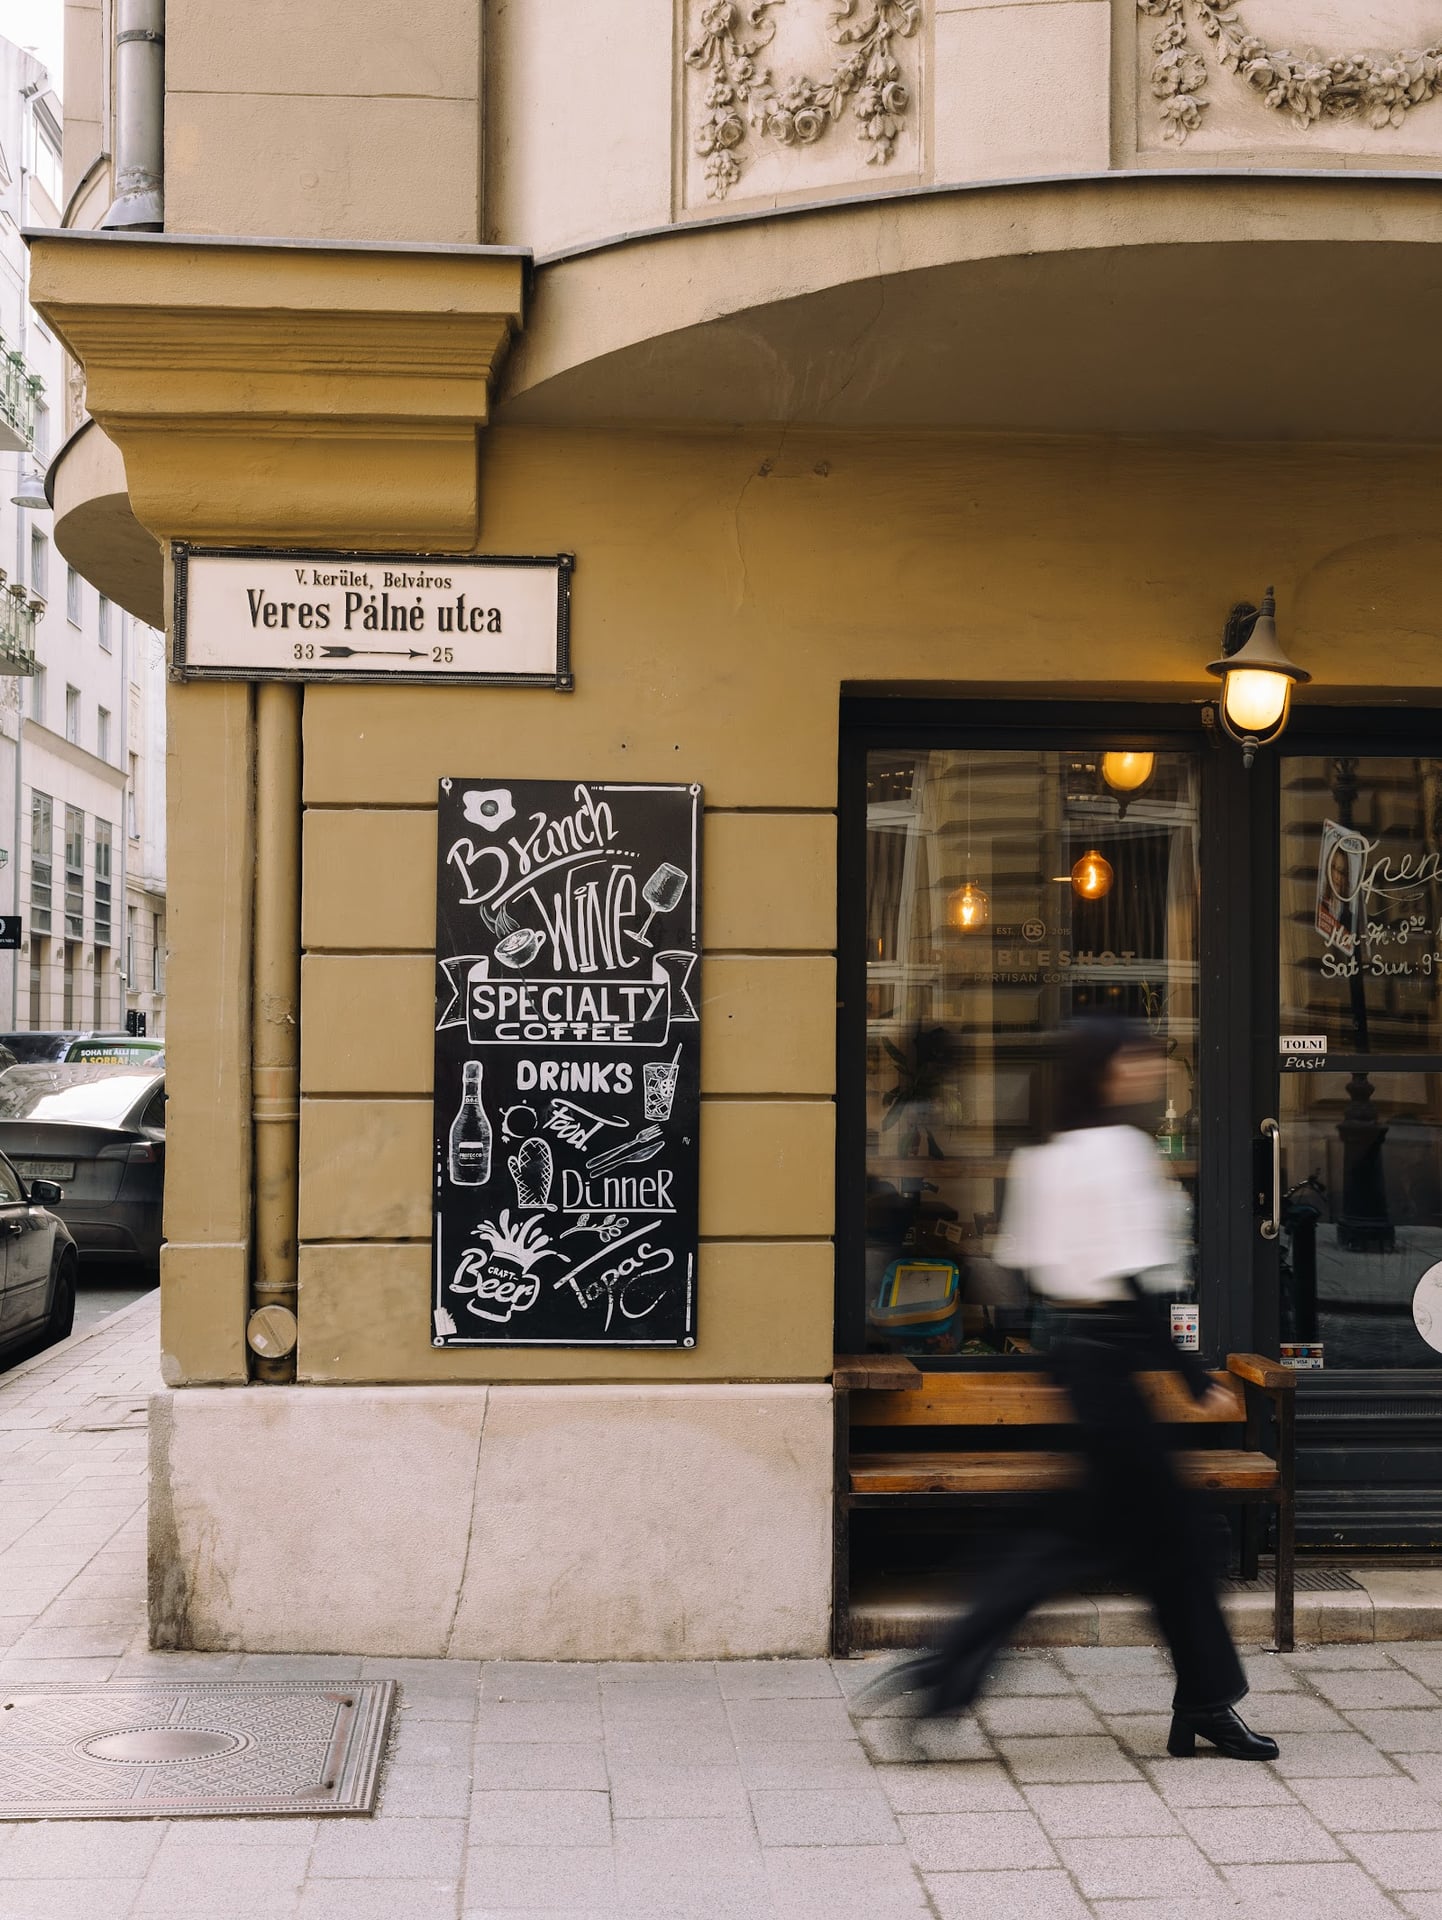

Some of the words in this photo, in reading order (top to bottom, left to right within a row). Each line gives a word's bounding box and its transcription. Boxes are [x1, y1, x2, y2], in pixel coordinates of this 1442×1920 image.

[294, 568, 307, 586] V.
[312, 569, 374, 591] kerület,
[383, 570, 452, 590] Belváros
[246, 588, 331, 630] Veres
[343, 591, 425, 633] Pálné
[437, 593, 502, 634] utca
[293, 643, 315, 660] 33
[432, 646, 454, 664] 25
[447, 784, 619, 905] Brunch
[472, 984, 666, 1023] SPECIALTY
[495, 1022, 635, 1041] COFFEE
[1283, 1040, 1323, 1049] TOLNI
[448, 1247, 535, 1304] Beer
